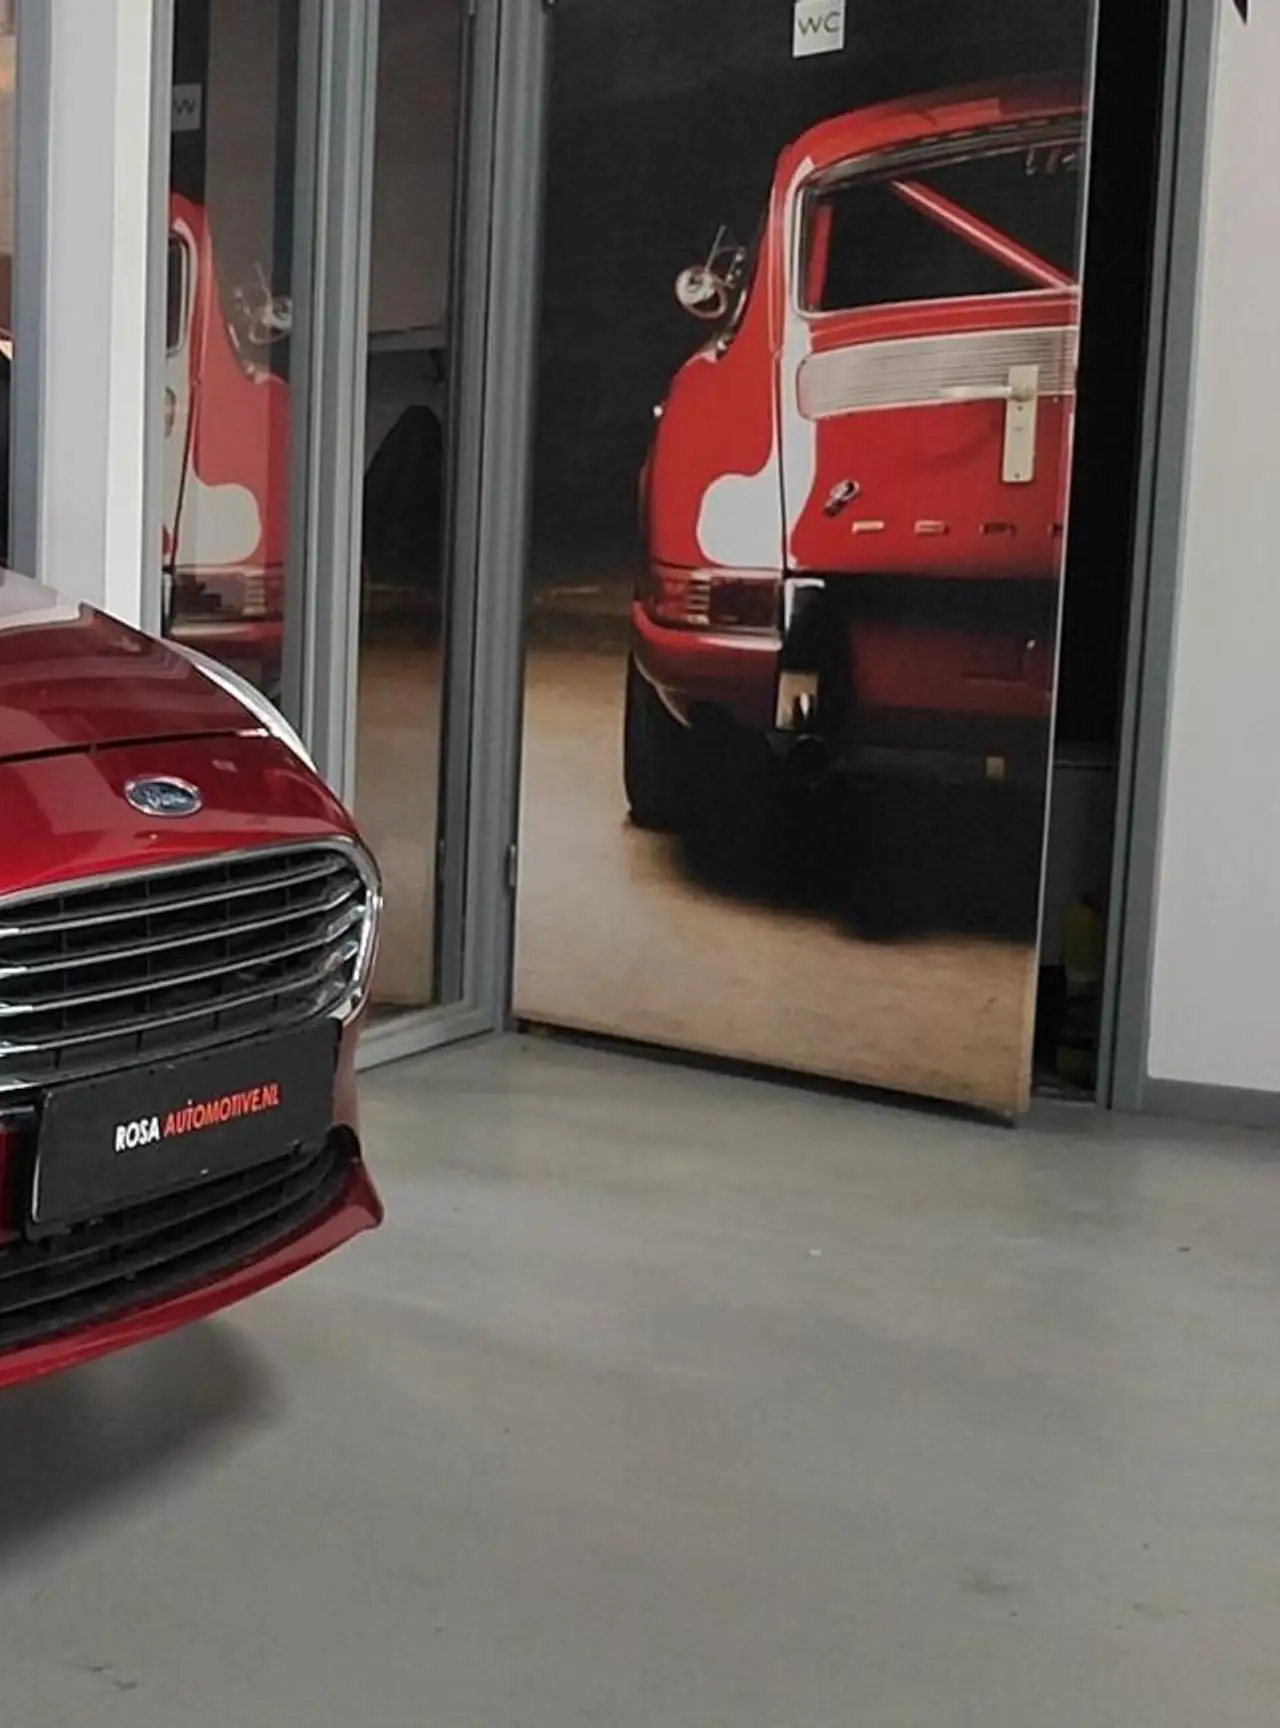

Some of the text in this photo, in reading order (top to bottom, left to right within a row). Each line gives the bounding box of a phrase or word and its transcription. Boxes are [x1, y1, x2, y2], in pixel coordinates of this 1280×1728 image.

[798, 10, 841, 37] WC
[114, 1083, 280, 1153] ROSA AUTOMOTIVE.NL
